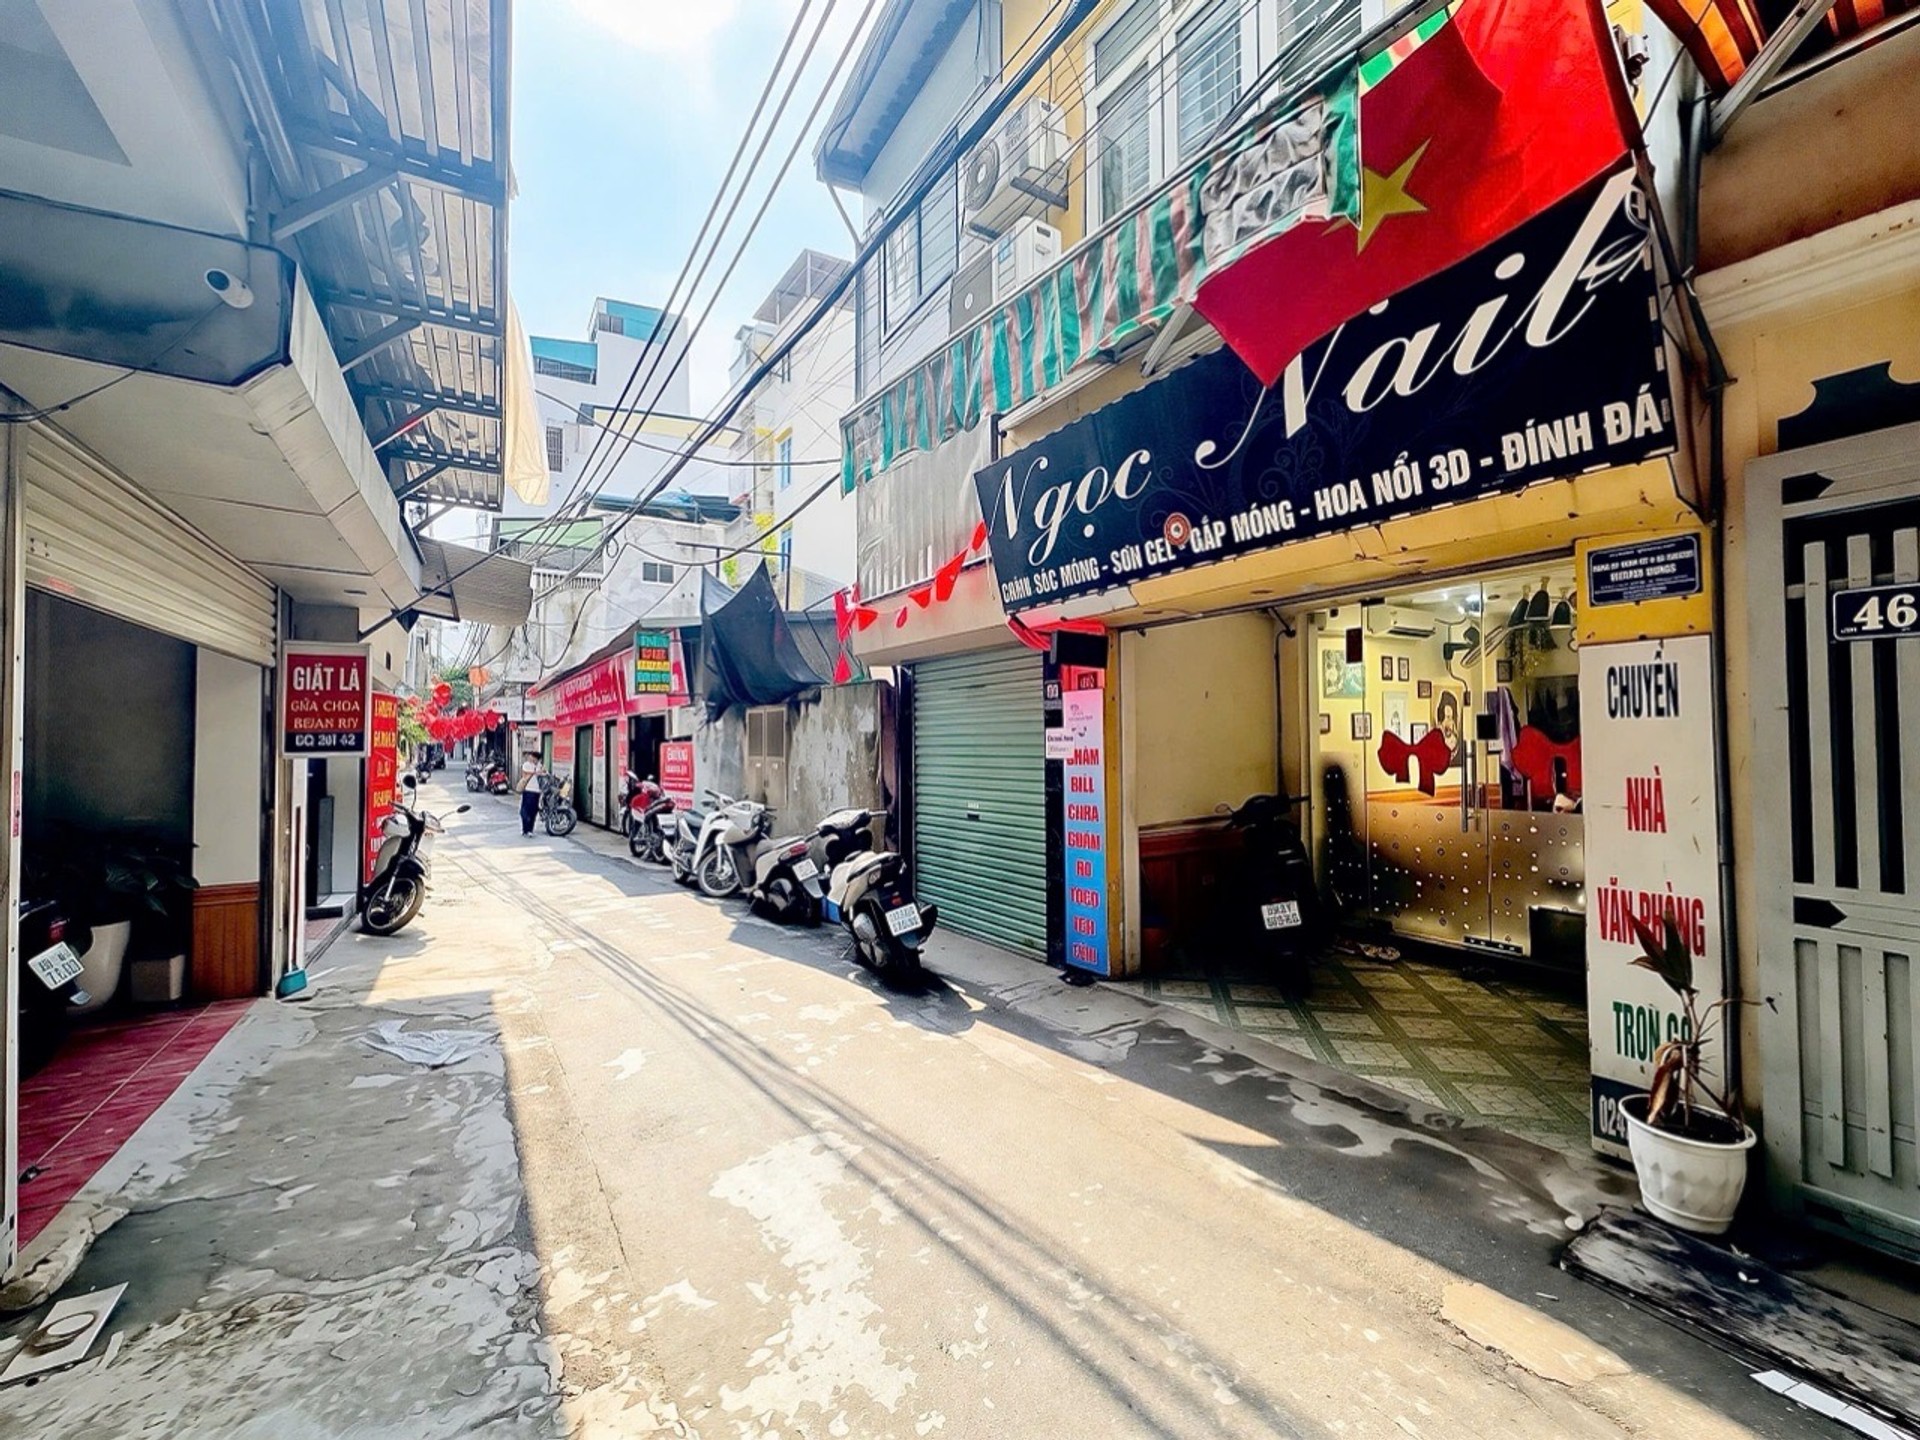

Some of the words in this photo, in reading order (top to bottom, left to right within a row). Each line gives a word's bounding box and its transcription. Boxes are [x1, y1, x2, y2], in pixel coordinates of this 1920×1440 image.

[989, 449, 1152, 567] Ngọc
[1059, 556, 1101, 588] MÓNG
[1230, 500, 1296, 543] MÓNG
[1313, 478, 1368, 521] HOA
[1429, 448, 1471, 490] 3D
[1502, 419, 1594, 472] ĐÍNH
[1603, 383, 1664, 445] ĐÁ
[1853, 593, 1918, 631] 46
[1626, 765, 1667, 834] NHÀ
[1597, 877, 1635, 945] VĂN
